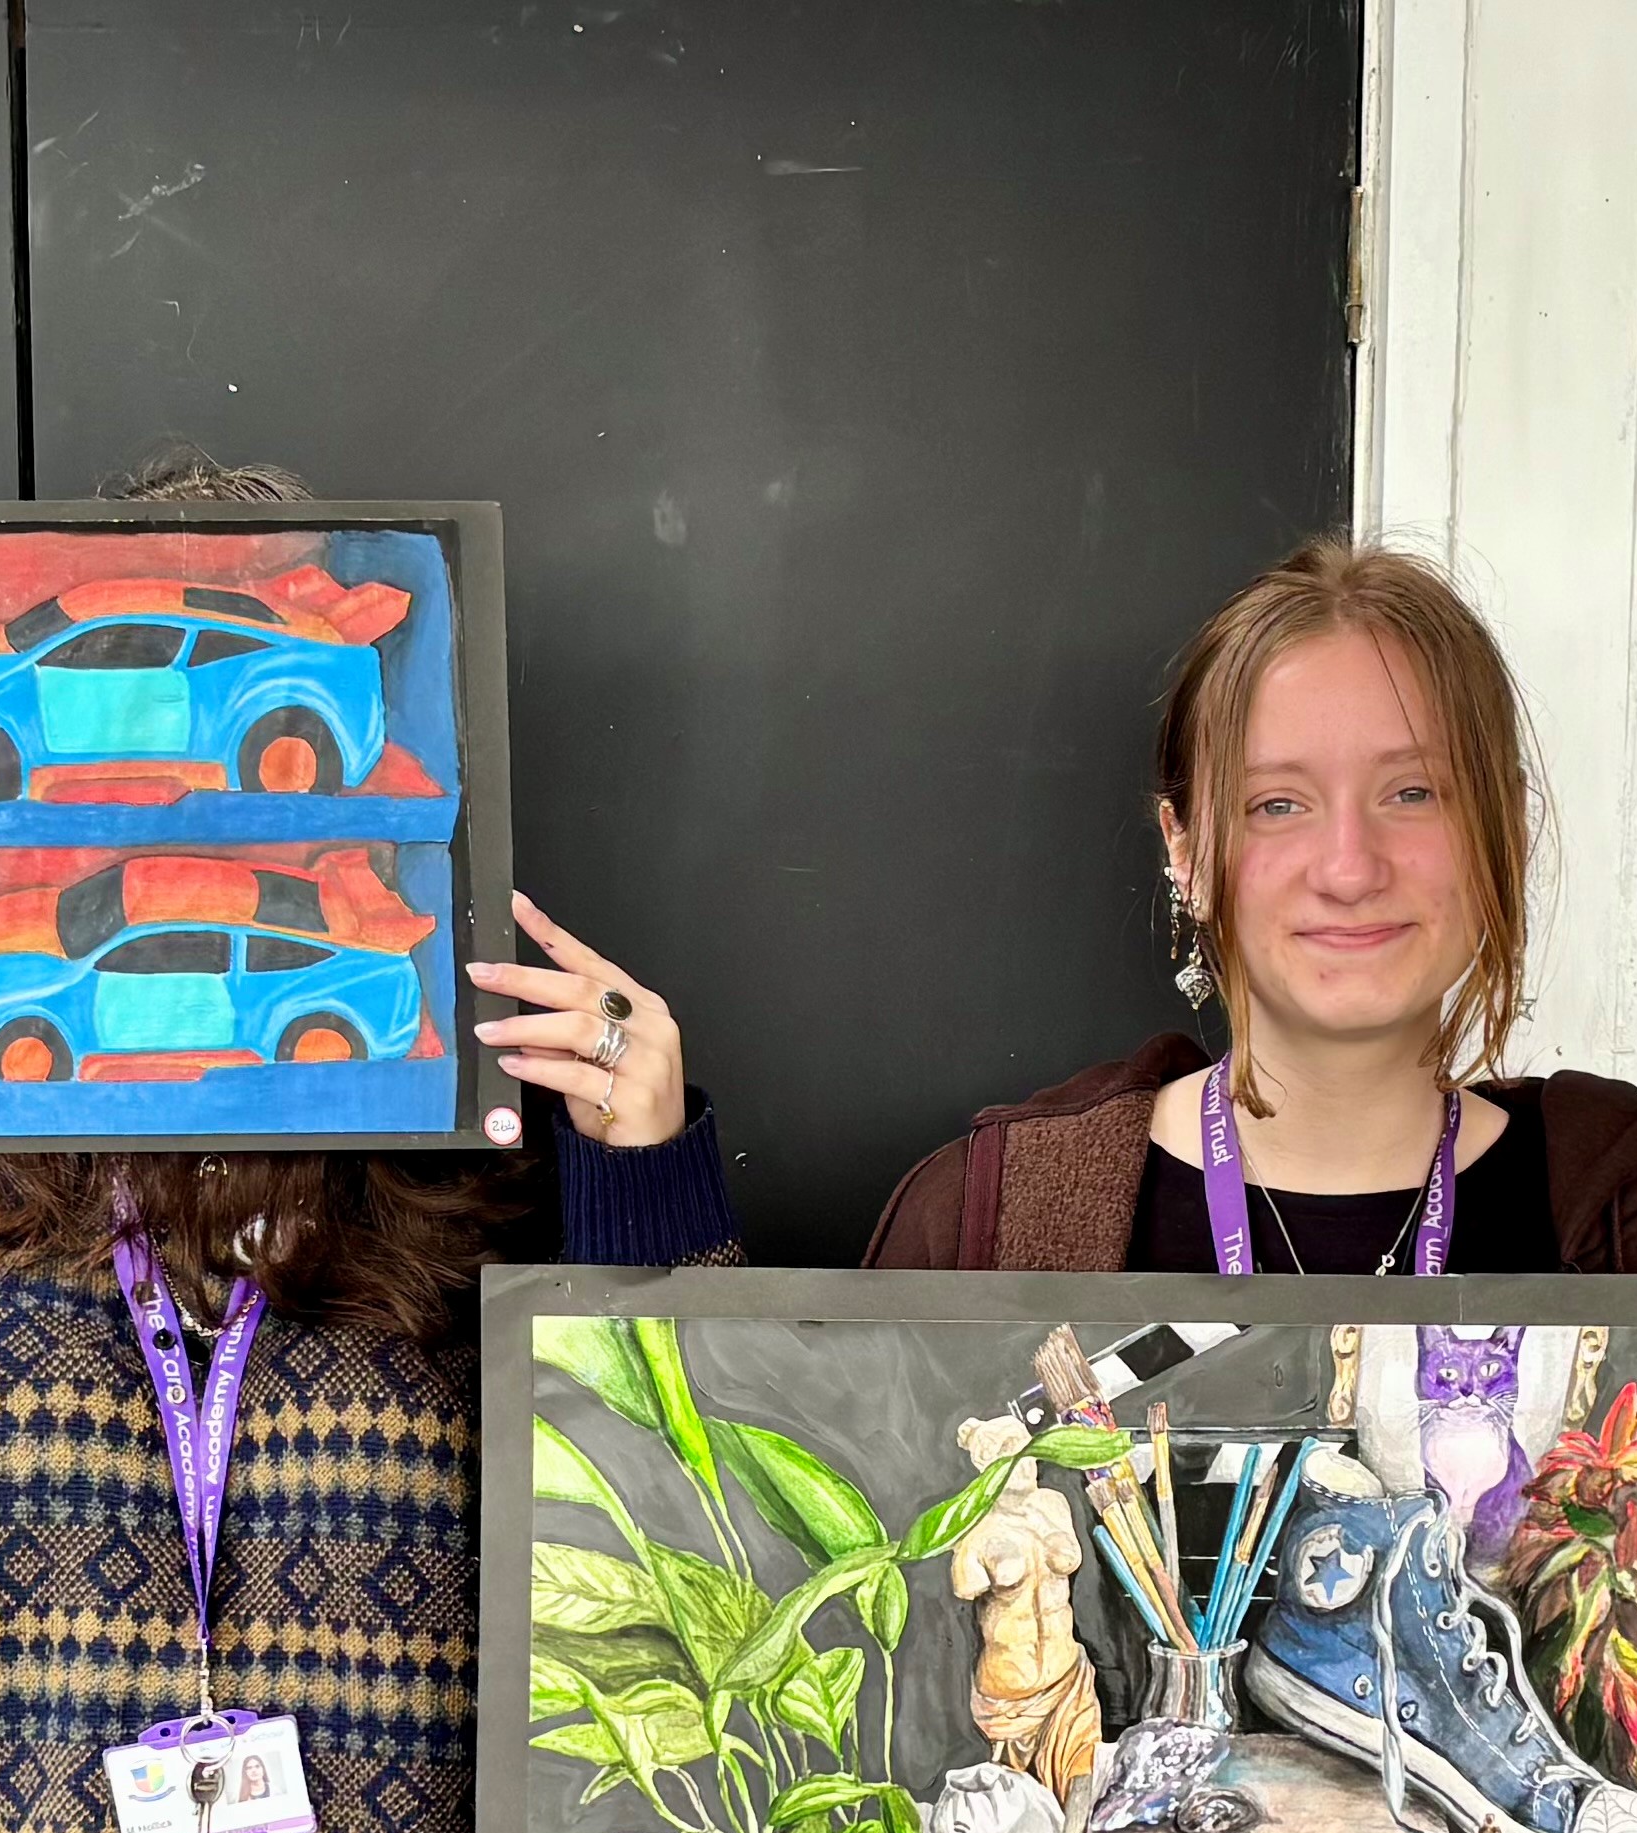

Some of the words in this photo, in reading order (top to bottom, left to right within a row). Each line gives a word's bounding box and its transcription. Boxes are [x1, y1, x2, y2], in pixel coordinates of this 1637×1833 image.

[1209, 1116, 1234, 1166] Trust
[1223, 1226, 1243, 1276] The
[1425, 1237, 1443, 1277] am
[205, 1369, 236, 1486] Academy
